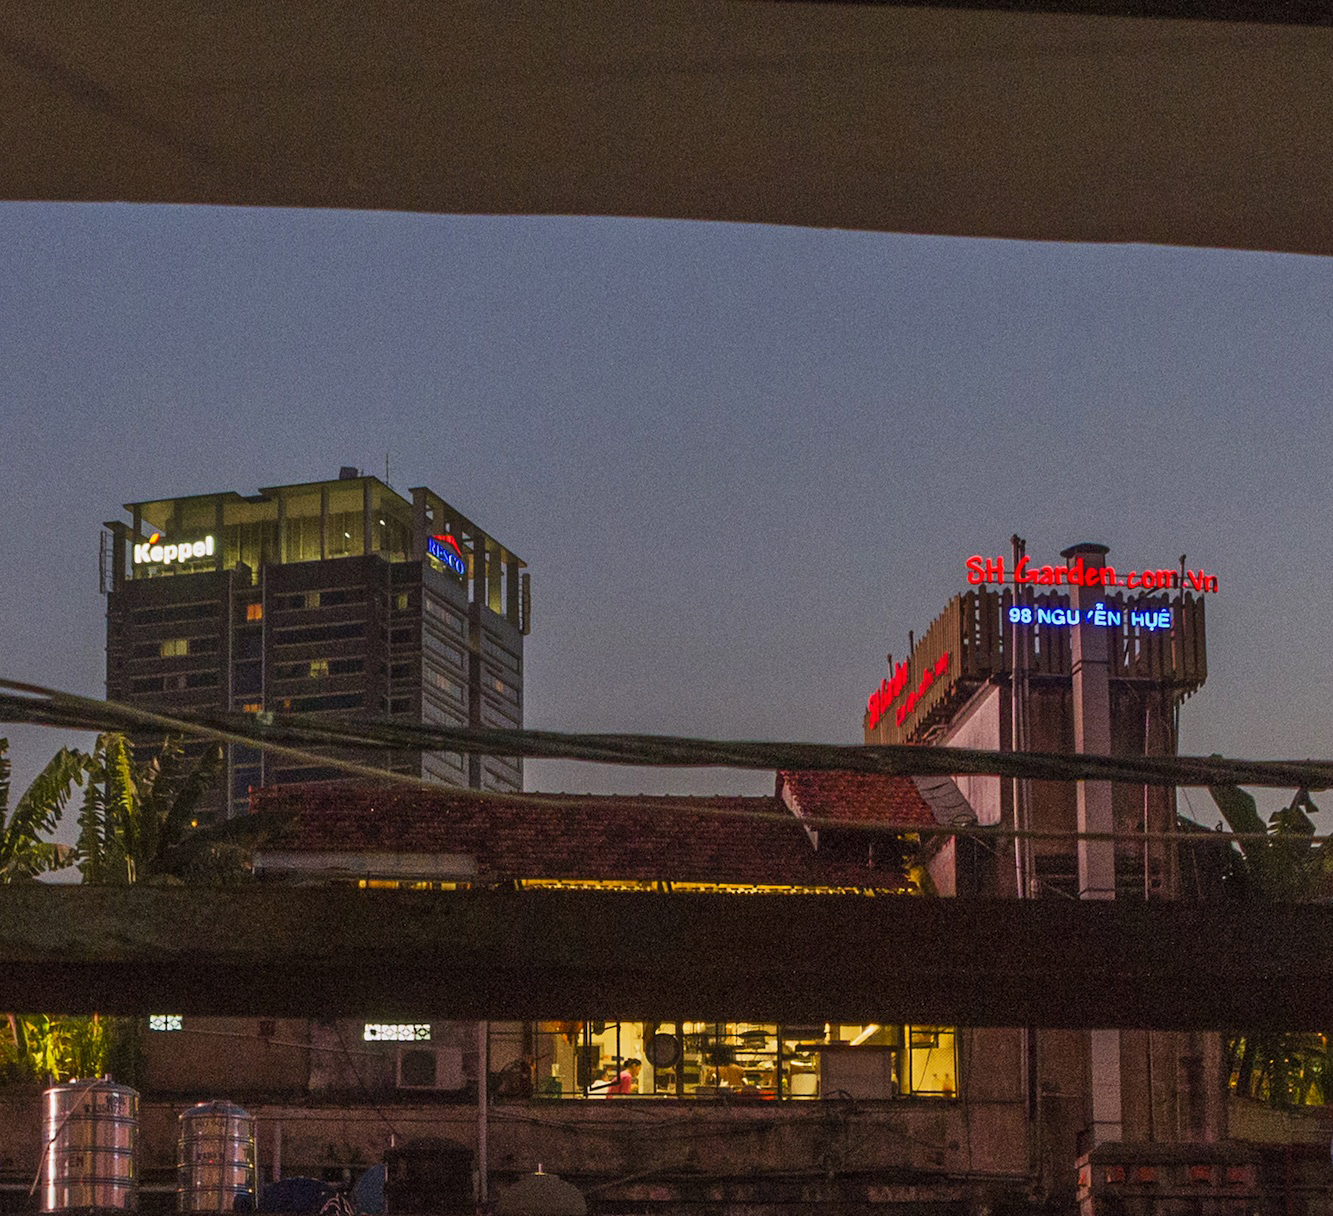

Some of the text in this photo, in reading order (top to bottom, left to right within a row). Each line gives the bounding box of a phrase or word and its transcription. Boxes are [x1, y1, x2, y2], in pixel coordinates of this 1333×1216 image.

[134, 536, 214, 564] Keppel
[966, 555, 1004, 585] SH
[1009, 607, 1033, 624] 98
